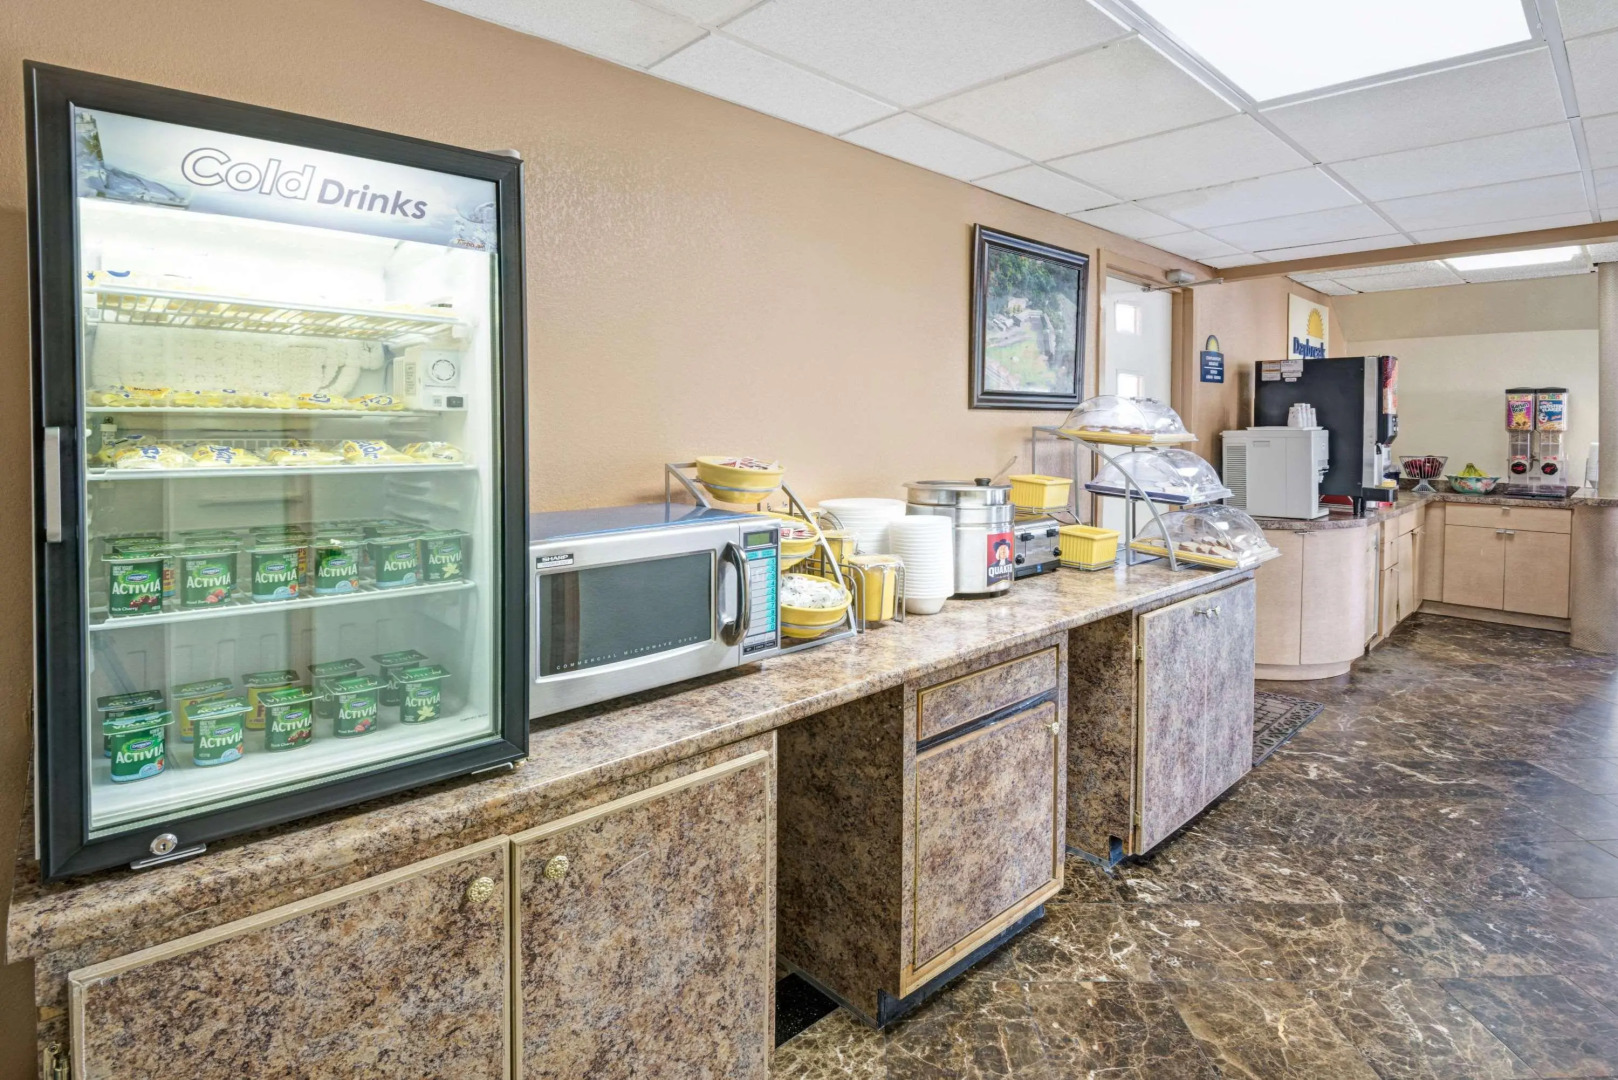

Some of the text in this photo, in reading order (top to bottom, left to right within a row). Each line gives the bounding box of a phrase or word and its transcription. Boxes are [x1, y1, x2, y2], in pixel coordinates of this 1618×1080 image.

[181, 147, 428, 220] Cold Drinks
[1293, 336, 1326, 360] Daybreak
[541, 554, 569, 563] SHARP
[255, 568, 298, 583] ACTIVIA
[318, 563, 358, 578] ACTIVIA
[112, 578, 161, 595] ACTIVIA
[186, 572, 231, 589] ACTIVIA
[556, 635, 699, 671] COMMERCIAL MICROWAVE OVEN
[405, 693, 441, 707] ACTIVIA
[339, 703, 378, 720] ACTIVIA
[271, 714, 313, 733] ACTIVIA
[199, 729, 244, 749] ACTIVIA
[115, 744, 165, 764] ACTIVIA
